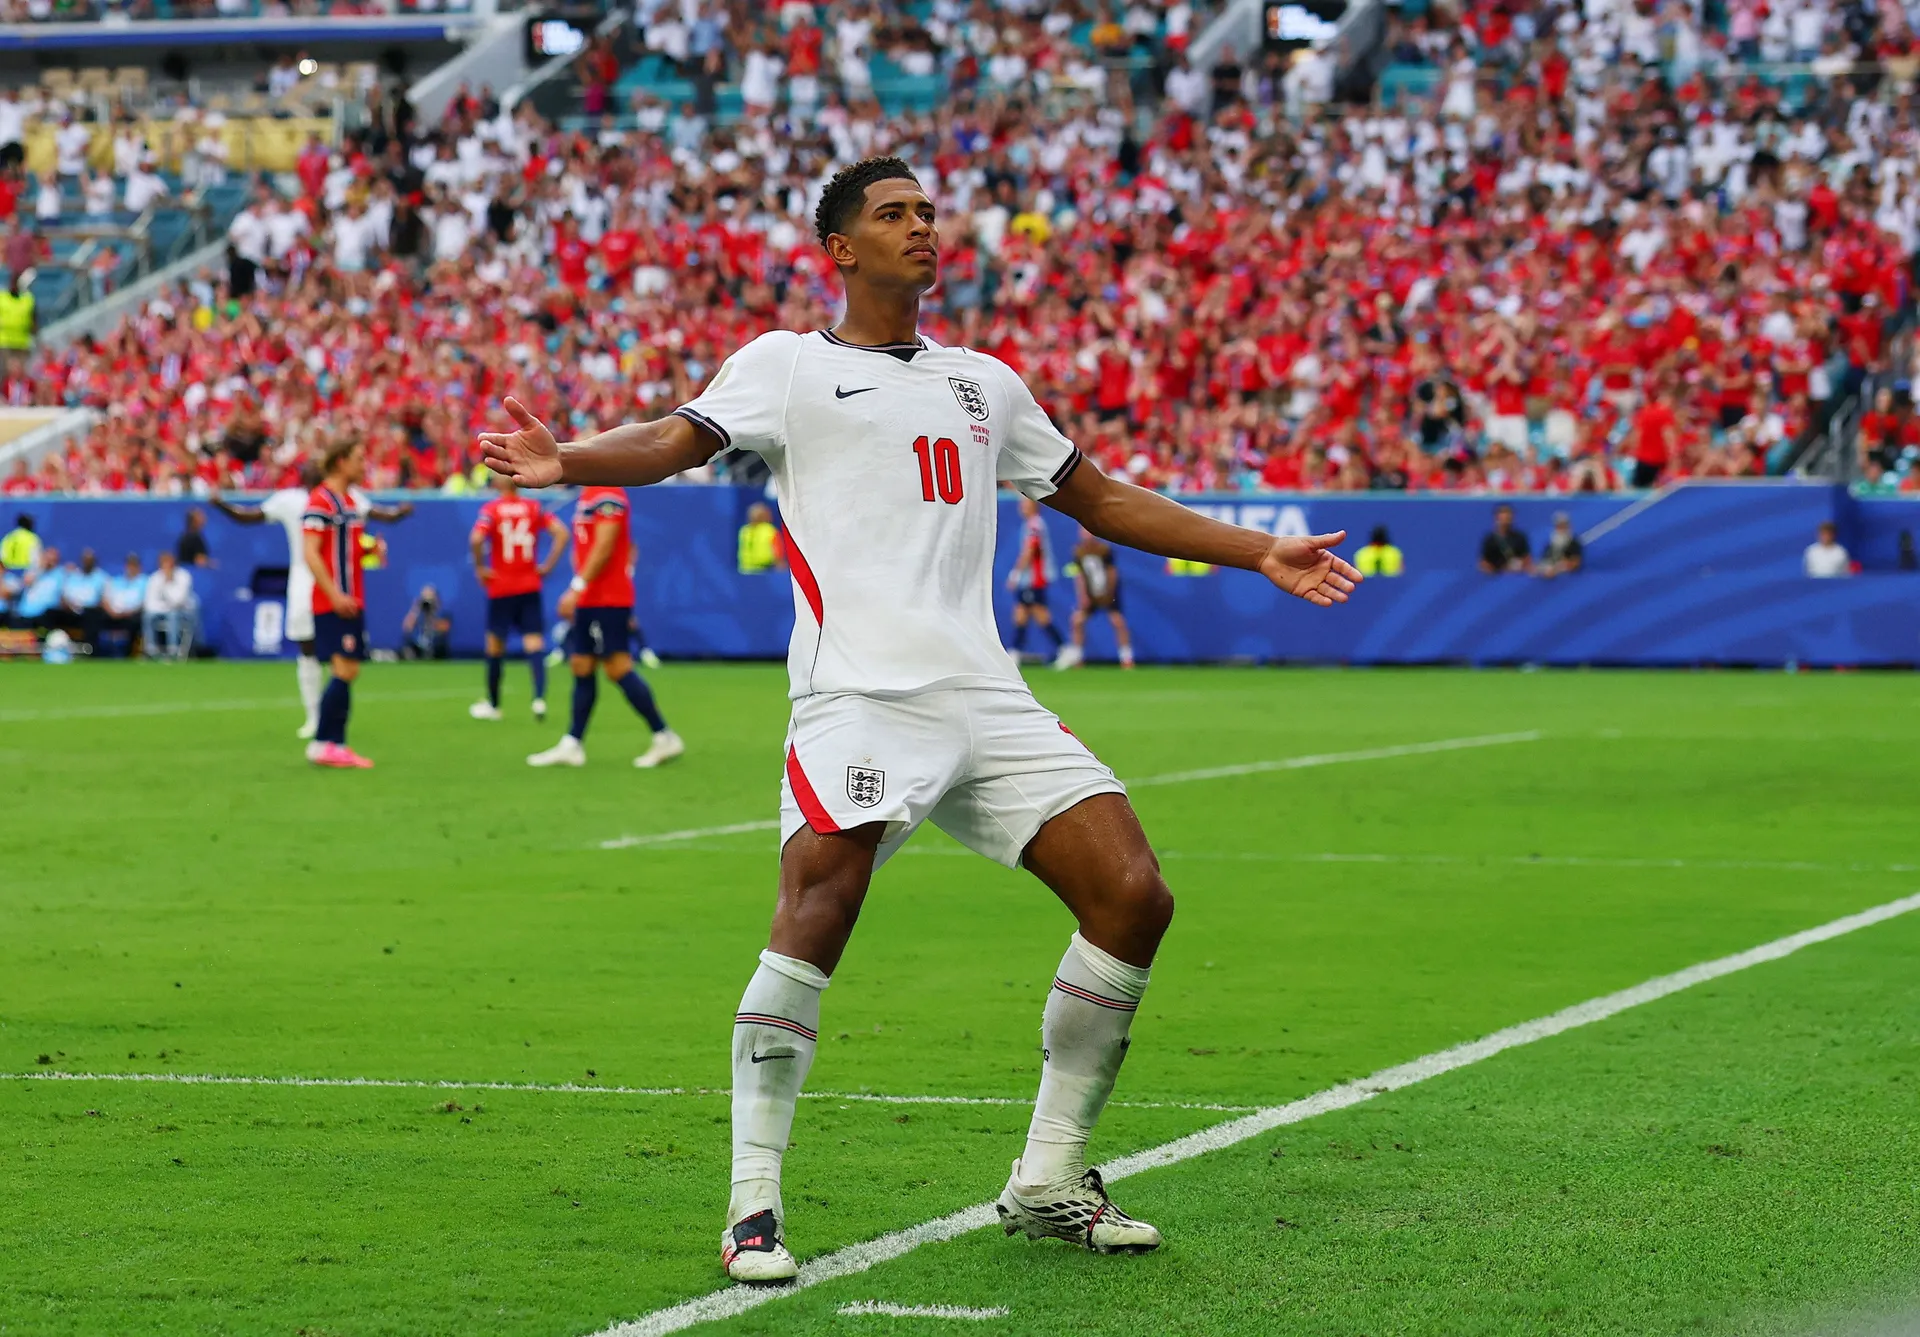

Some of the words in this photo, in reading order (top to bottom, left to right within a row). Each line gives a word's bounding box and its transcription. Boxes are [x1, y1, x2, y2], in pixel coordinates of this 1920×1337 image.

[913, 436, 964, 504] 10
[498, 518, 535, 563] 14
[1190, 503, 1312, 537] IFA
